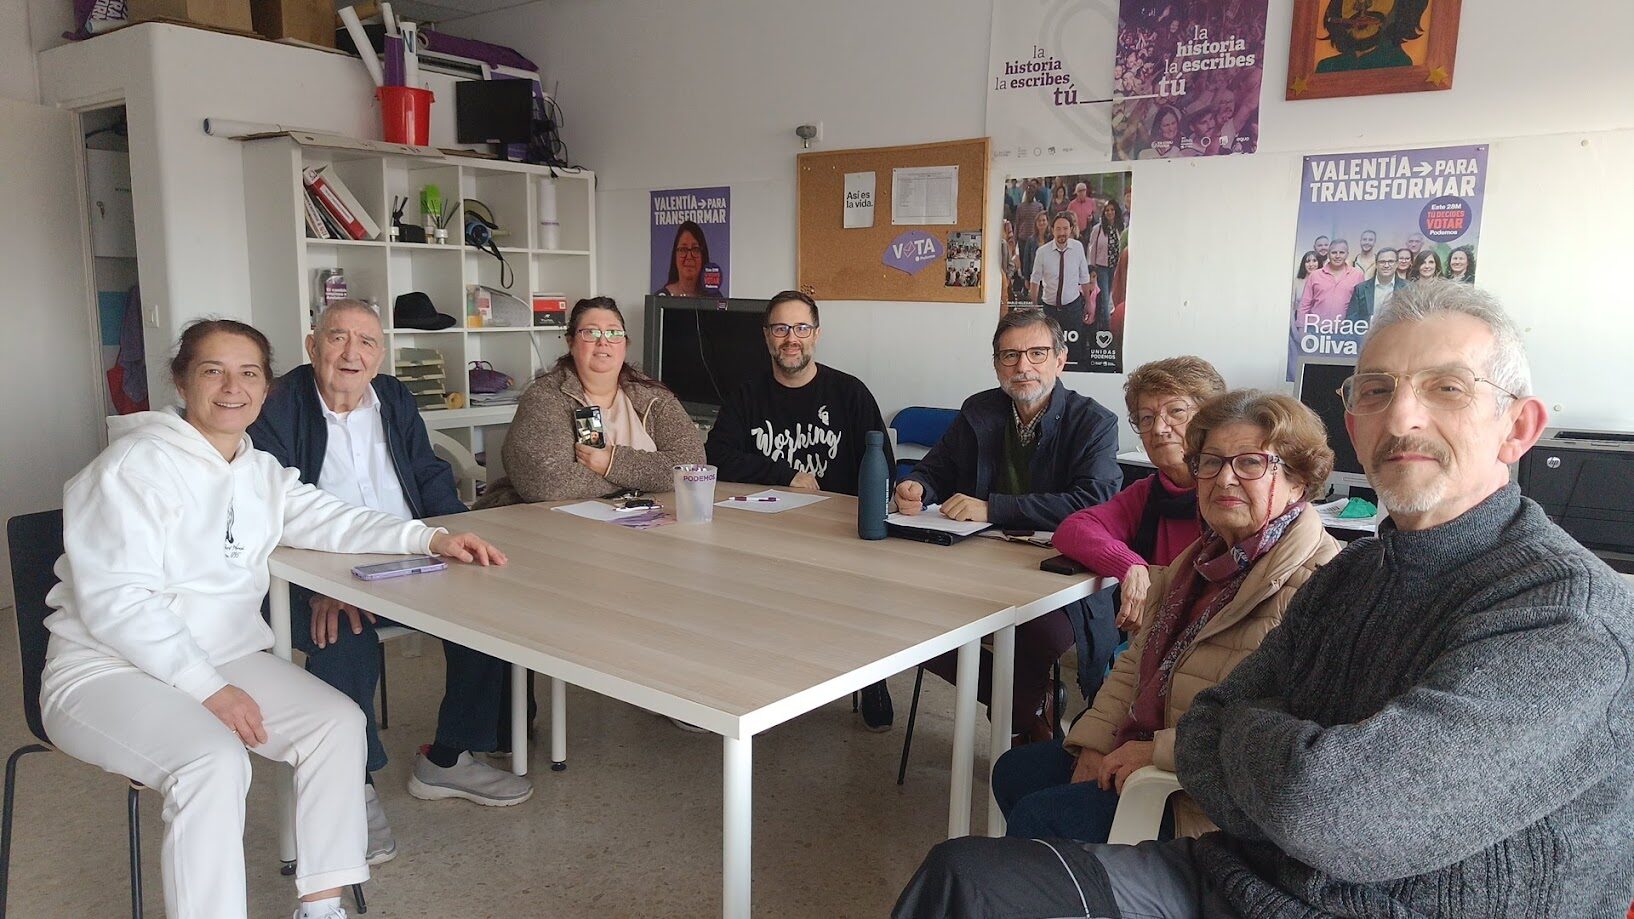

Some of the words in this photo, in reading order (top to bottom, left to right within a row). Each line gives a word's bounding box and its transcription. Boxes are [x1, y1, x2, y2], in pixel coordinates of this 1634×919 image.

[1193, 25, 1208, 41] la
[1033, 45, 1045, 59] la
[1176, 35, 1245, 58] historia
[1005, 56, 1062, 75] historia
[1164, 59, 1179, 75] la
[1182, 53, 1256, 73] escribes
[995, 77, 1007, 91] la
[1010, 72, 1070, 89] escribes
[1159, 72, 1187, 98] tú
[1053, 83, 1078, 106] tú
[1311, 155, 1411, 181] VALENTÍA
[1435, 158, 1479, 176] PARA
[860, 191, 871, 199] es
[1309, 175, 1476, 203] TRANSFORMAR
[654, 194, 698, 211] VALENTÍA
[707, 198, 727, 209] PARA
[846, 200, 854, 208] la
[855, 199, 873, 208] vida.
[1431, 203, 1446, 211] Este
[654, 208, 727, 226] TRANSFORMAR
[1427, 217, 1463, 230] VOTAR
[1436, 210, 1465, 218] DECIDES
[1303, 313, 1374, 336] Rafae
[1300, 334, 1358, 355] Oliva
[751, 419, 842, 461] Working
[683, 473, 716, 482] PODEMOS
